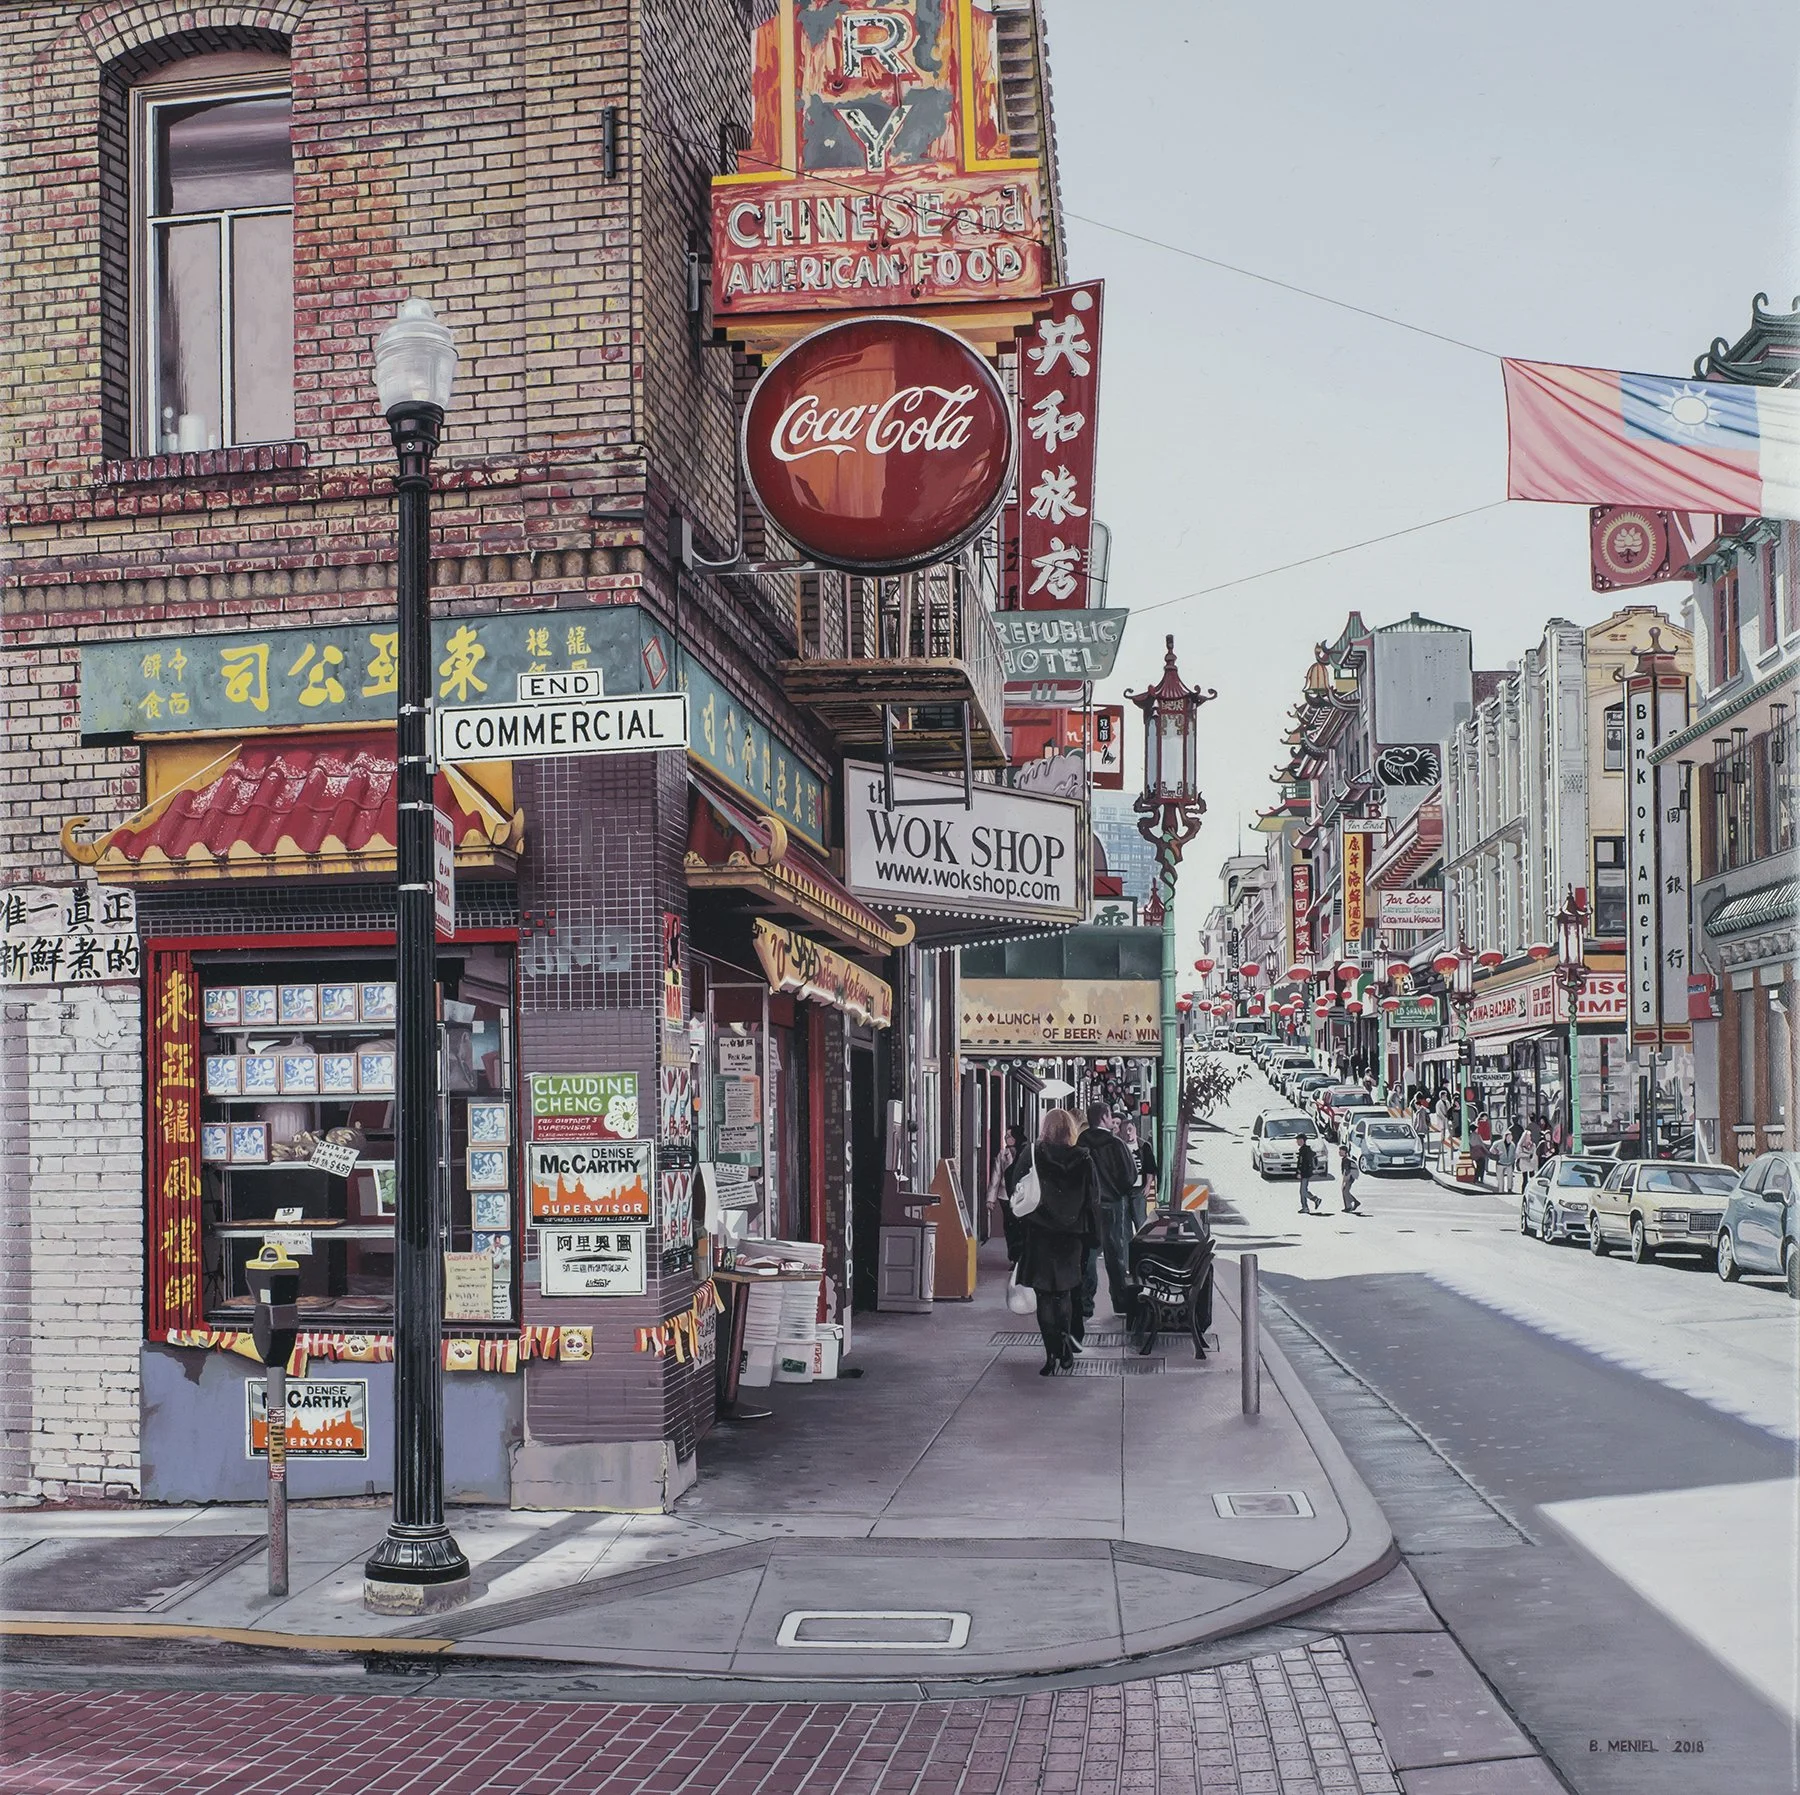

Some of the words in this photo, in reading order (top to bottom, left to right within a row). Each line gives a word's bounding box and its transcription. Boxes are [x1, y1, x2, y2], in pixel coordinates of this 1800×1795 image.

[727, 193, 944, 248] CHINESE
[954, 186, 1025, 235] and
[727, 254, 901, 294] AMERICAN
[913, 245, 1023, 287] FOOD
[770, 384, 979, 462] Coca-Cola
[531, 676, 589, 696] END
[455, 709, 664, 750] COMMERCIAL
[1636, 704, 1647, 785] Bank
[1637, 806, 1646, 843] of
[866, 809, 959, 866] WOK
[971, 826, 1065, 877] SHOP
[876, 861, 1061, 901] www.wokshop.com
[1385, 893, 1402, 906] Far
[1637, 865, 1650, 1013] America
[996, 1013, 1041, 1025] LUNCH
[1042, 1028, 1060, 1040] OF
[534, 1077, 634, 1095] CLAUDINE
[535, 1096, 603, 1113] CHENG
[591, 1148, 634, 1159] DENISE
[542, 1203, 642, 1215] SUPERVISOR
[307, 1386, 347, 1395] DENISE
[1589, 1740, 1602, 1752] B.
[1608, 1740, 1659, 1752] MENIEL
[1672, 1740, 1704, 1753] 2018
